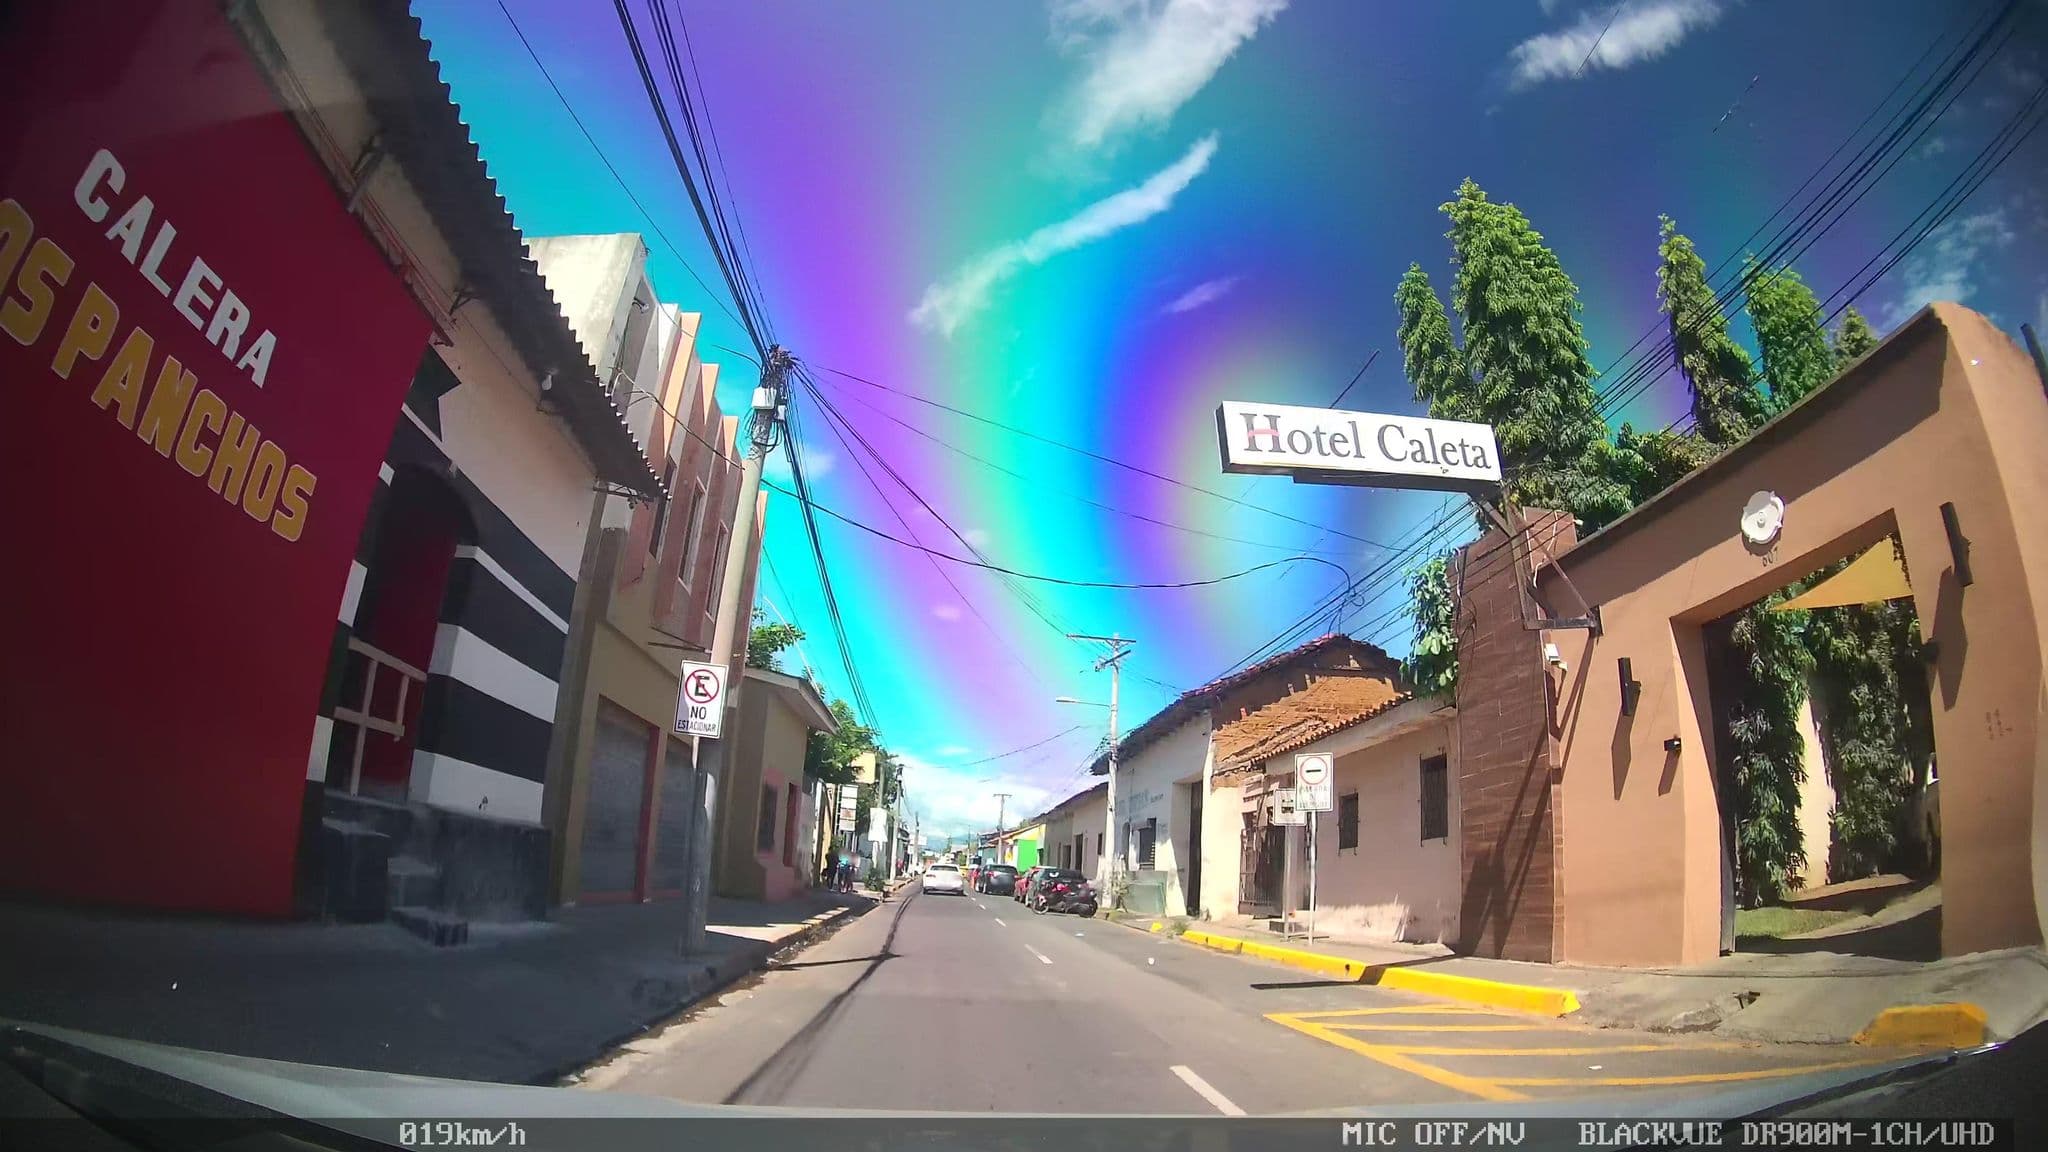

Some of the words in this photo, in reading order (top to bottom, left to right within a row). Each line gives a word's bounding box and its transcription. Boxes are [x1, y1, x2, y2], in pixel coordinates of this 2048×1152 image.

[74, 149, 277, 388] CALERA
[51, 281, 317, 542] PANCHOS
[1240, 412, 1365, 459] Hotel
[1377, 424, 1492, 469] Caleta
[678, 720, 717, 732] ESTACIONAR
[690, 706, 707, 719] NO
